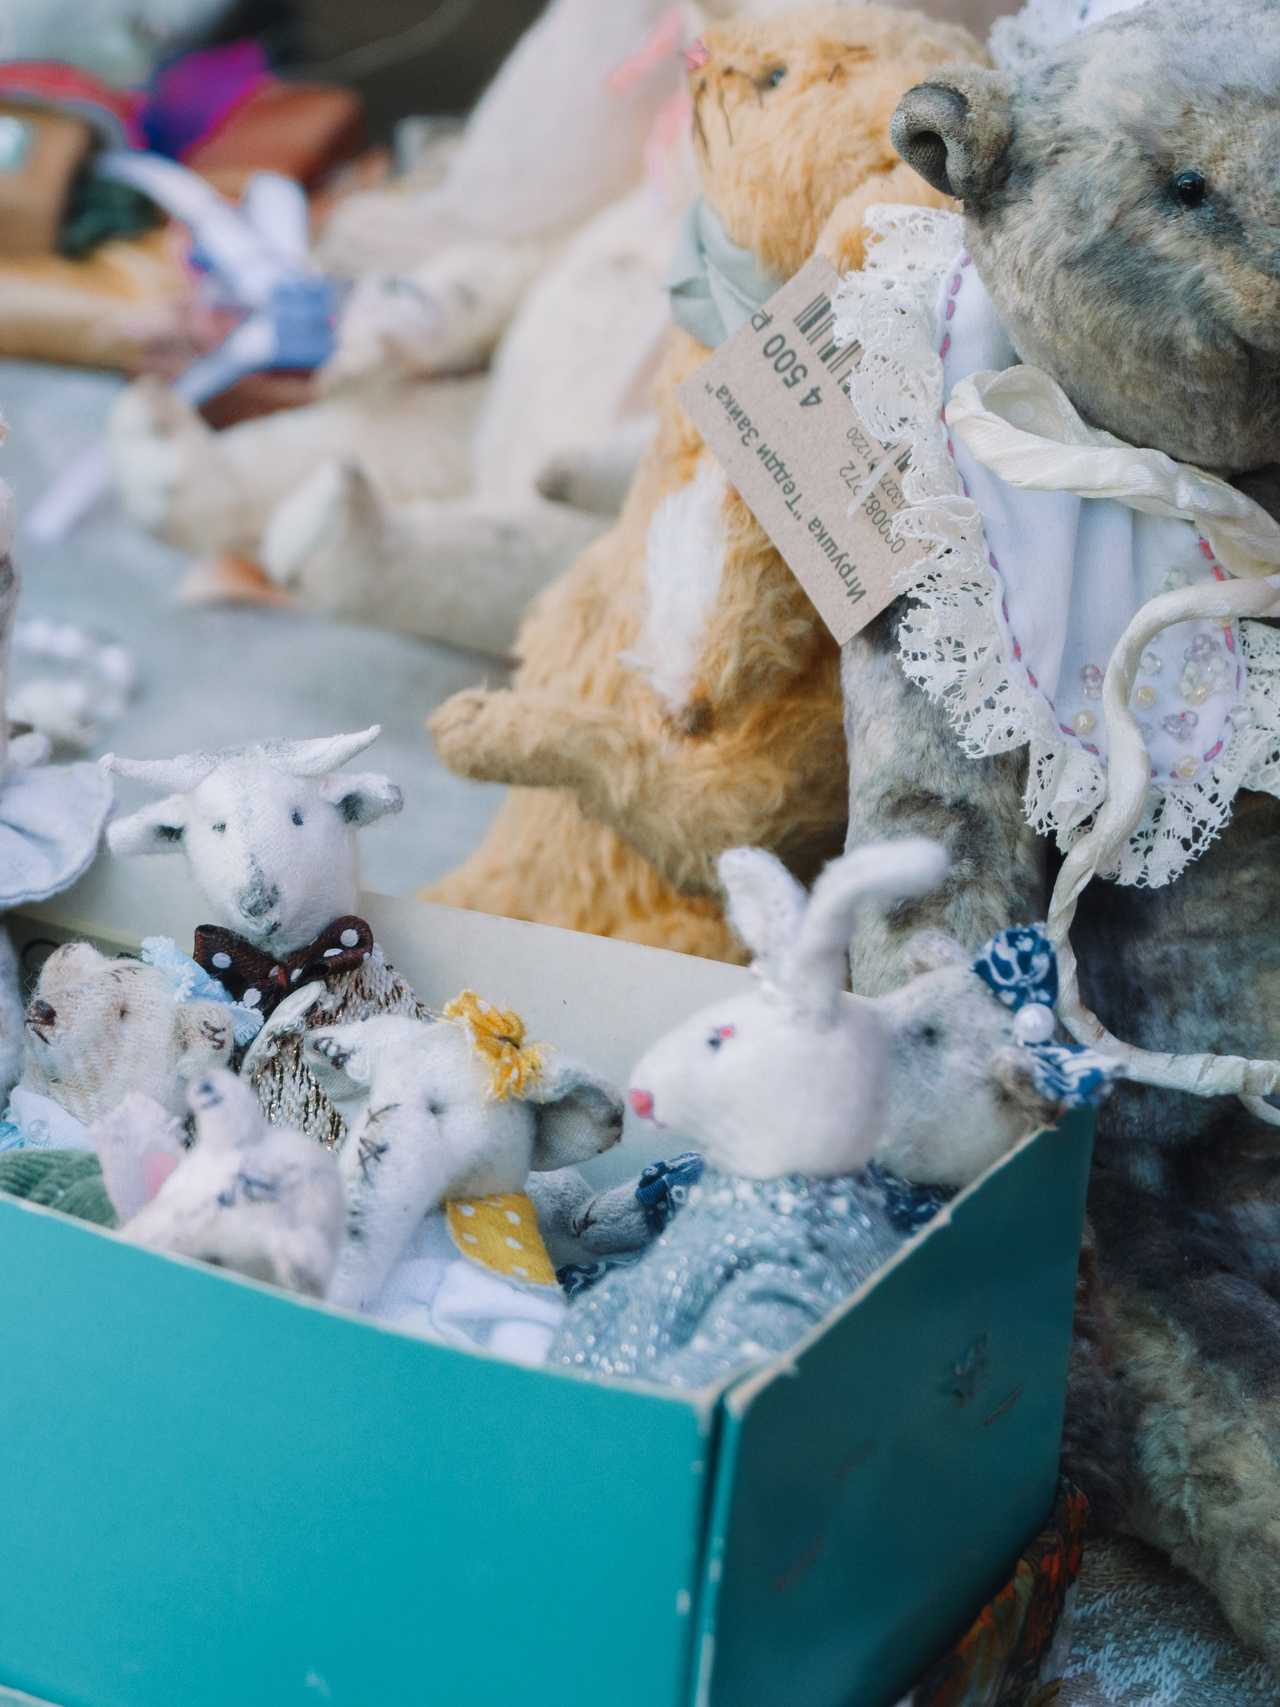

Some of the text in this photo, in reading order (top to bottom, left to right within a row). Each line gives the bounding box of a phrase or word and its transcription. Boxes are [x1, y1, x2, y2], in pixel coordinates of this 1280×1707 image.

[763, 334, 807, 388] 500
[799, 386, 822, 406] 4
[705, 383, 867, 605] Игрушка "Тедди Зайка"
